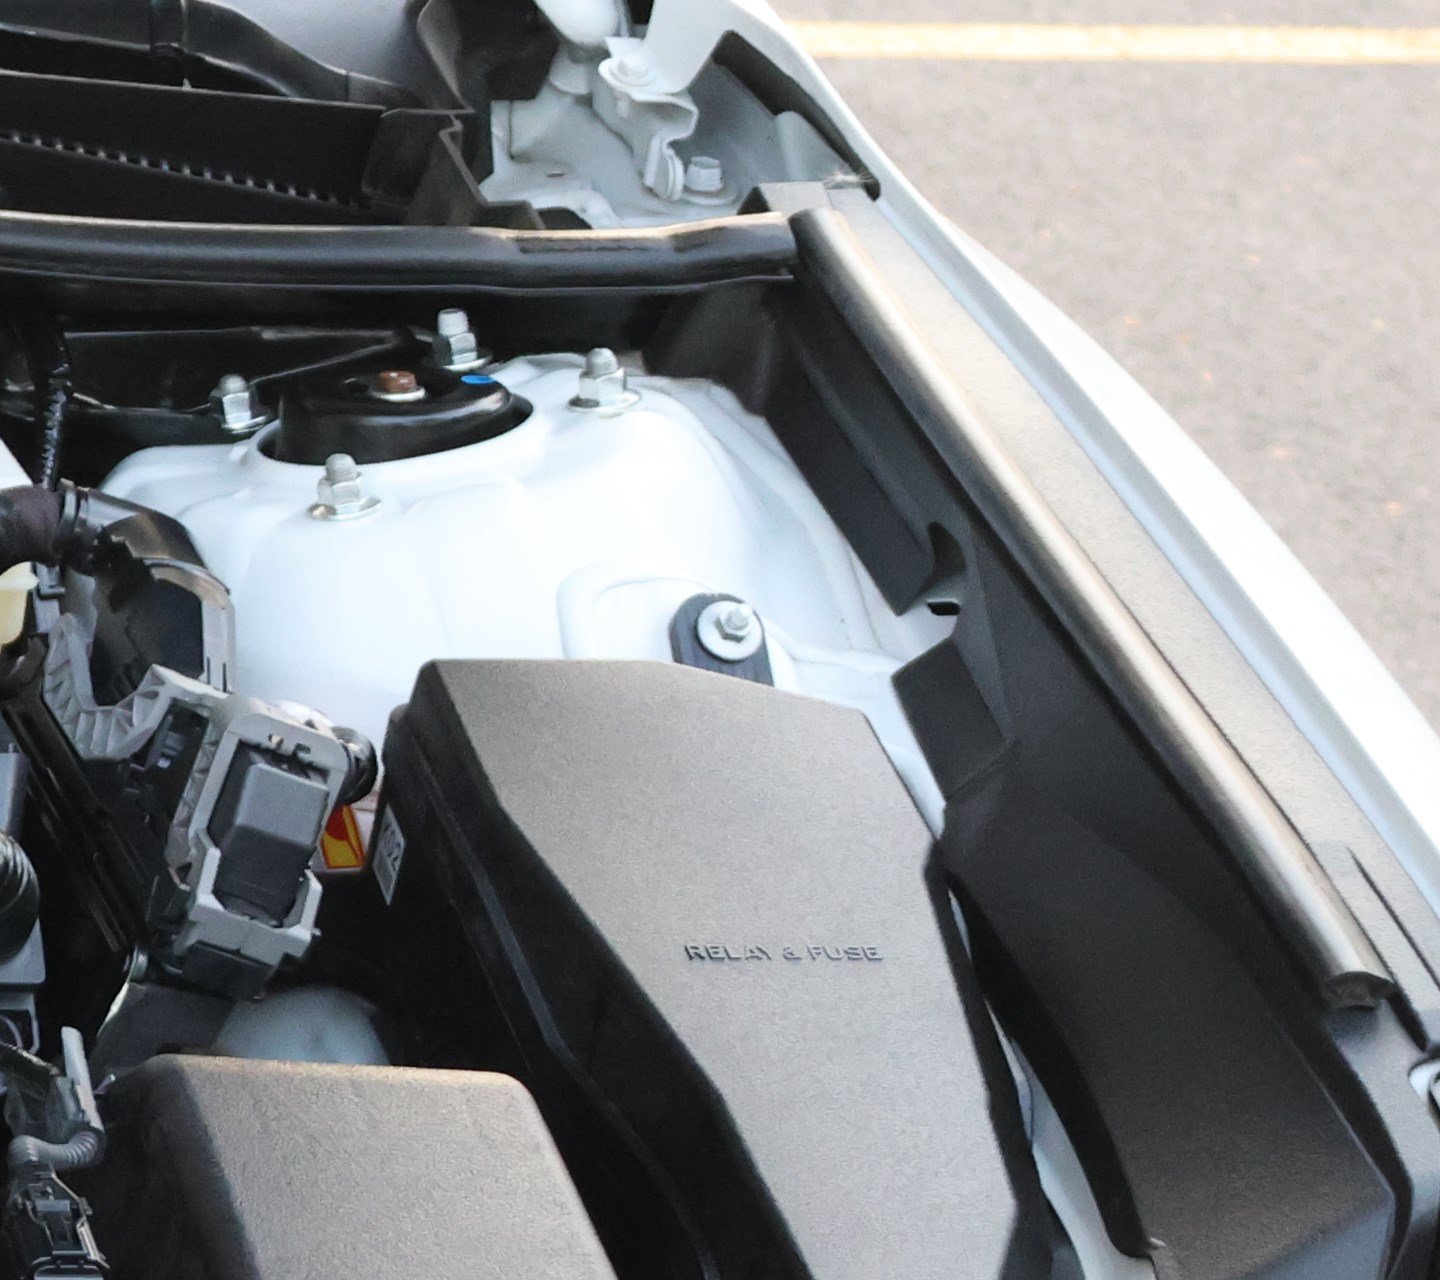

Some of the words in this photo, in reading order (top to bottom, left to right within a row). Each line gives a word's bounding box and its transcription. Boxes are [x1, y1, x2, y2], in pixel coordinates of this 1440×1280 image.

[683, 944, 772, 961] RELAY
[782, 945, 802, 960] &
[806, 945, 884, 962] FUSE
